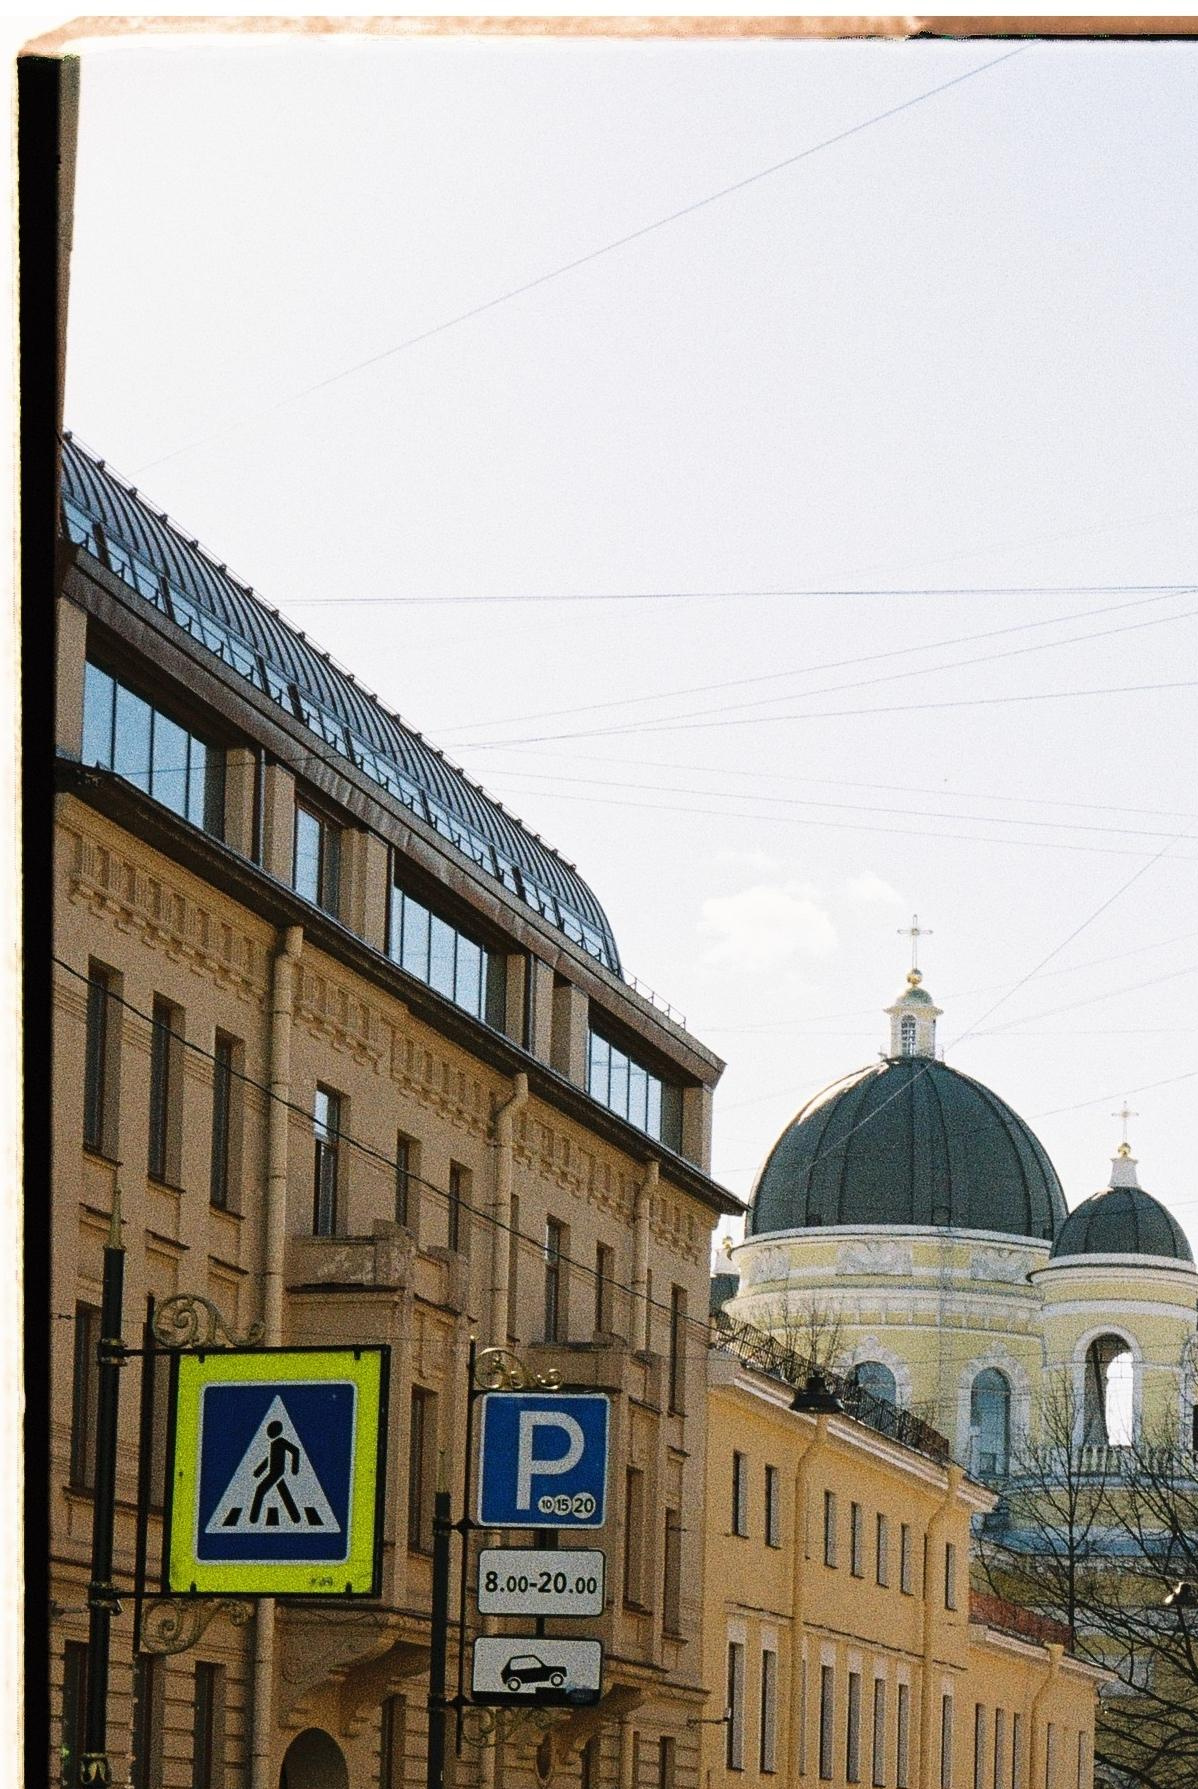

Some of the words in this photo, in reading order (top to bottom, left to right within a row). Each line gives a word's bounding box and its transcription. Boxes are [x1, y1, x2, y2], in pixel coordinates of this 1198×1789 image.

[517, 1411, 584, 1509] P
[541, 1499, 553, 1510] 10
[556, 1497, 569, 1511] 15
[574, 1497, 594, 1513] 20
[485, 1571, 597, 1594] 8.00-20.00
